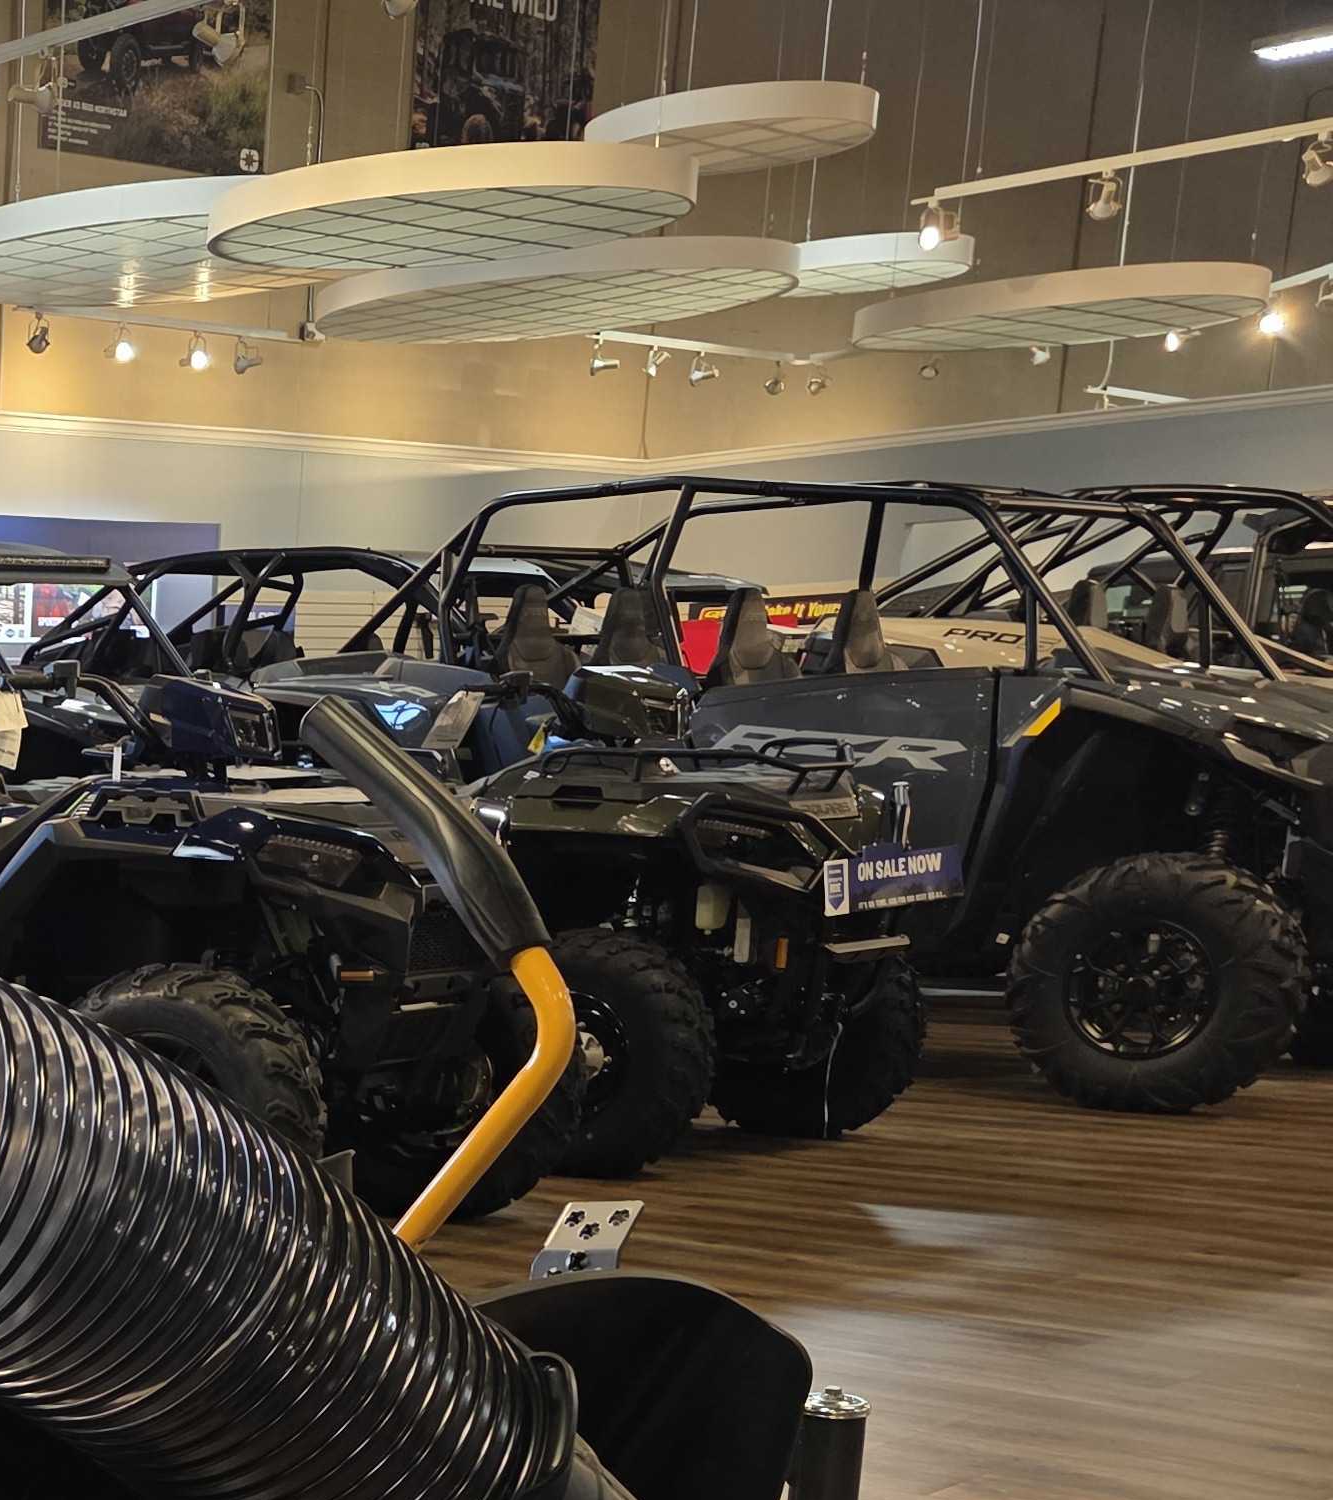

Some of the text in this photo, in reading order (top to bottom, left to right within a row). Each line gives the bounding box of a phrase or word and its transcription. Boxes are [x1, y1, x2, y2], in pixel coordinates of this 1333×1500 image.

[943, 627, 1024, 645] PRO
[857, 861, 874, 882] ON
[875, 857, 907, 880] SALE
[907, 852, 942, 875] NOW
